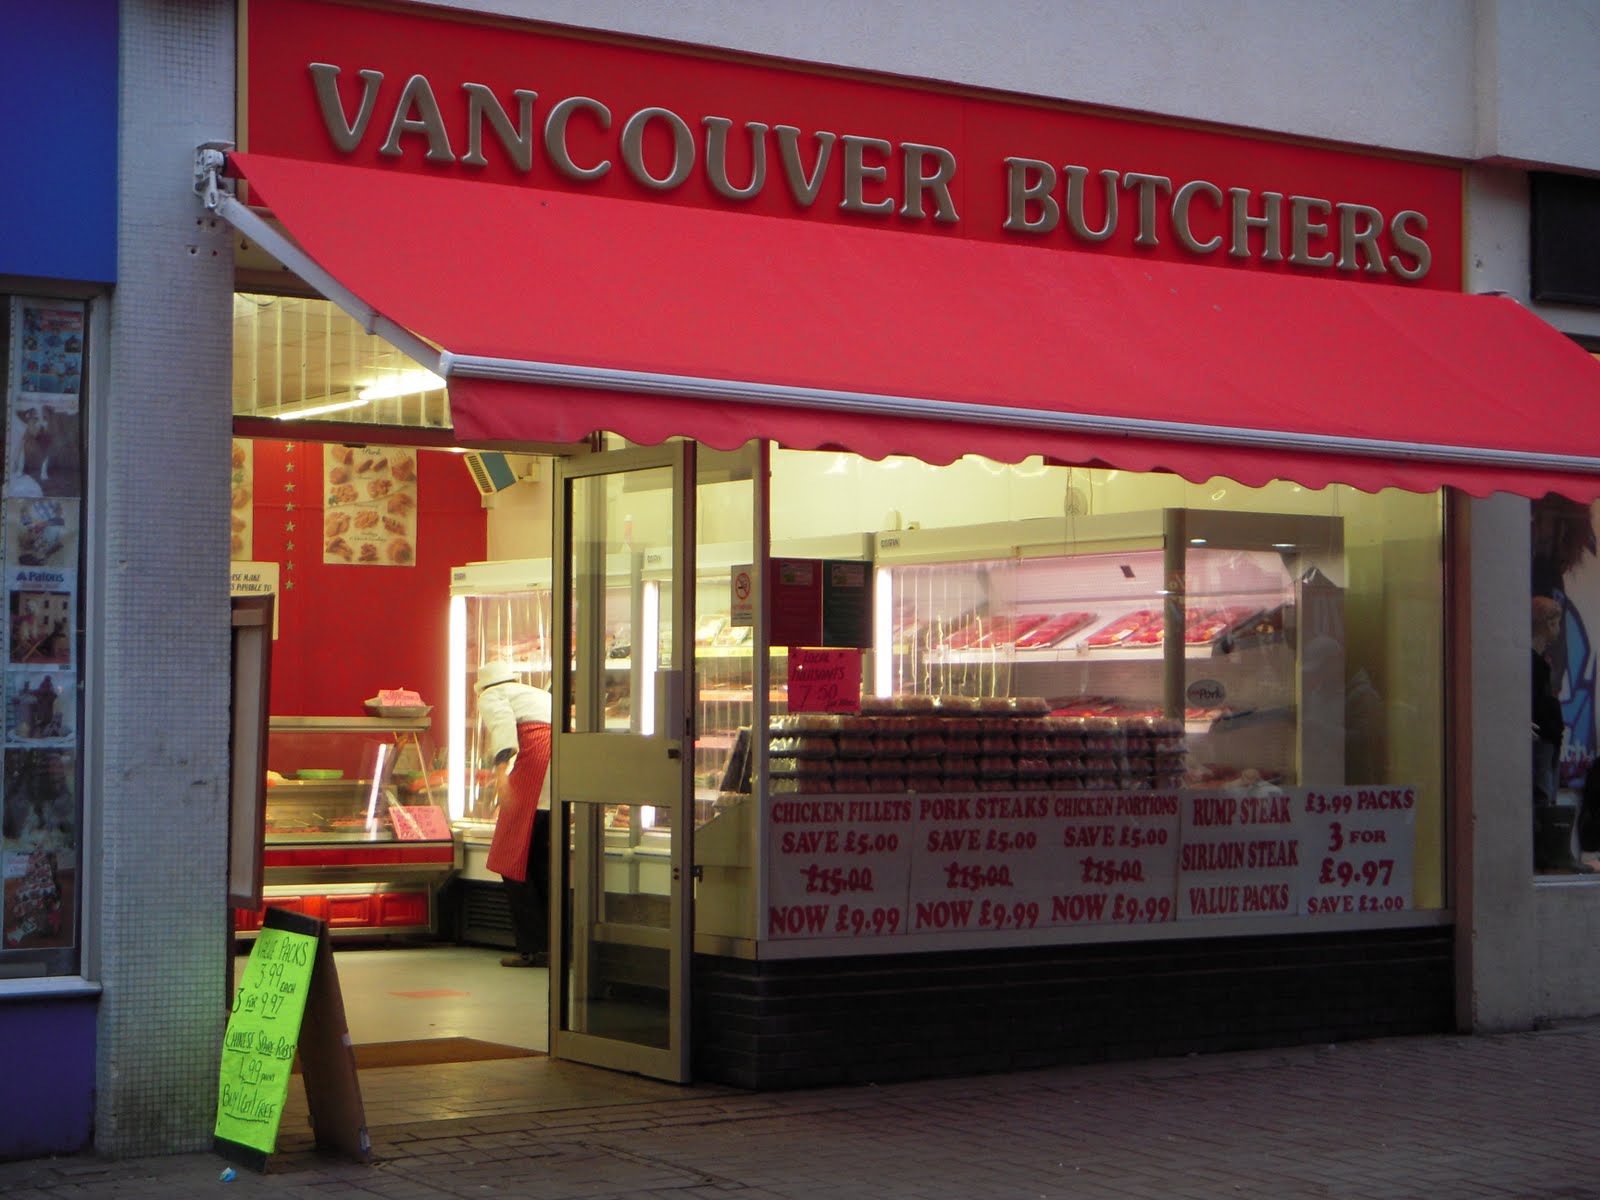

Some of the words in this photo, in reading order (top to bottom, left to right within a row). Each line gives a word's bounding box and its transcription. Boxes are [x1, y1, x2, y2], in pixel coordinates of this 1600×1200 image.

[309, 62, 961, 223] VANCOUVER
[1003, 156, 1432, 281] BUTCHERS
[771, 800, 844, 824] CHICKEN
[847, 799, 913, 822] FILLETS
[919, 798, 972, 821] PORK
[975, 796, 1050, 820] STEAKS
[1054, 796, 1114, 818] CHICKEN
[1116, 794, 1178, 816] PORTIONS
[1192, 798, 1237, 827] RUMP
[1240, 797, 1291, 824] STEAK
[1305, 791, 1353, 814] £3.99
[1356, 789, 1415, 811] PACKS
[781, 830, 840, 854] SAVE
[843, 830, 899, 855] £5.00
[926, 828, 982, 853] SAVE
[985, 828, 1038, 853] £5.00
[1063, 825, 1115, 848] SAVE
[1118, 825, 1168, 848] £5.00
[1328, 822, 1344, 852] 3
[1349, 829, 1387, 844] FOR
[1181, 841, 1243, 871] SIRLOIN
[1247, 839, 1298, 868] STEAK
[1318, 858, 1394, 887] £9.97
[1051, 895, 1110, 923] NOW
[1112, 894, 1171, 924] £9.99
[1189, 886, 1239, 916] VALUE
[1243, 884, 1289, 913] PACKS
[1308, 895, 1354, 915] SAVE
[1359, 896, 1404, 914] £2.00
[768, 905, 830, 935] NOW
[835, 904, 900, 936] £9.99
[915, 900, 974, 930] NOW
[978, 899, 1040, 930] £9.99
[279, 936, 309, 967] PACKS
[232, 987, 245, 1013] 3
[255, 1098, 277, 1118] FREE
